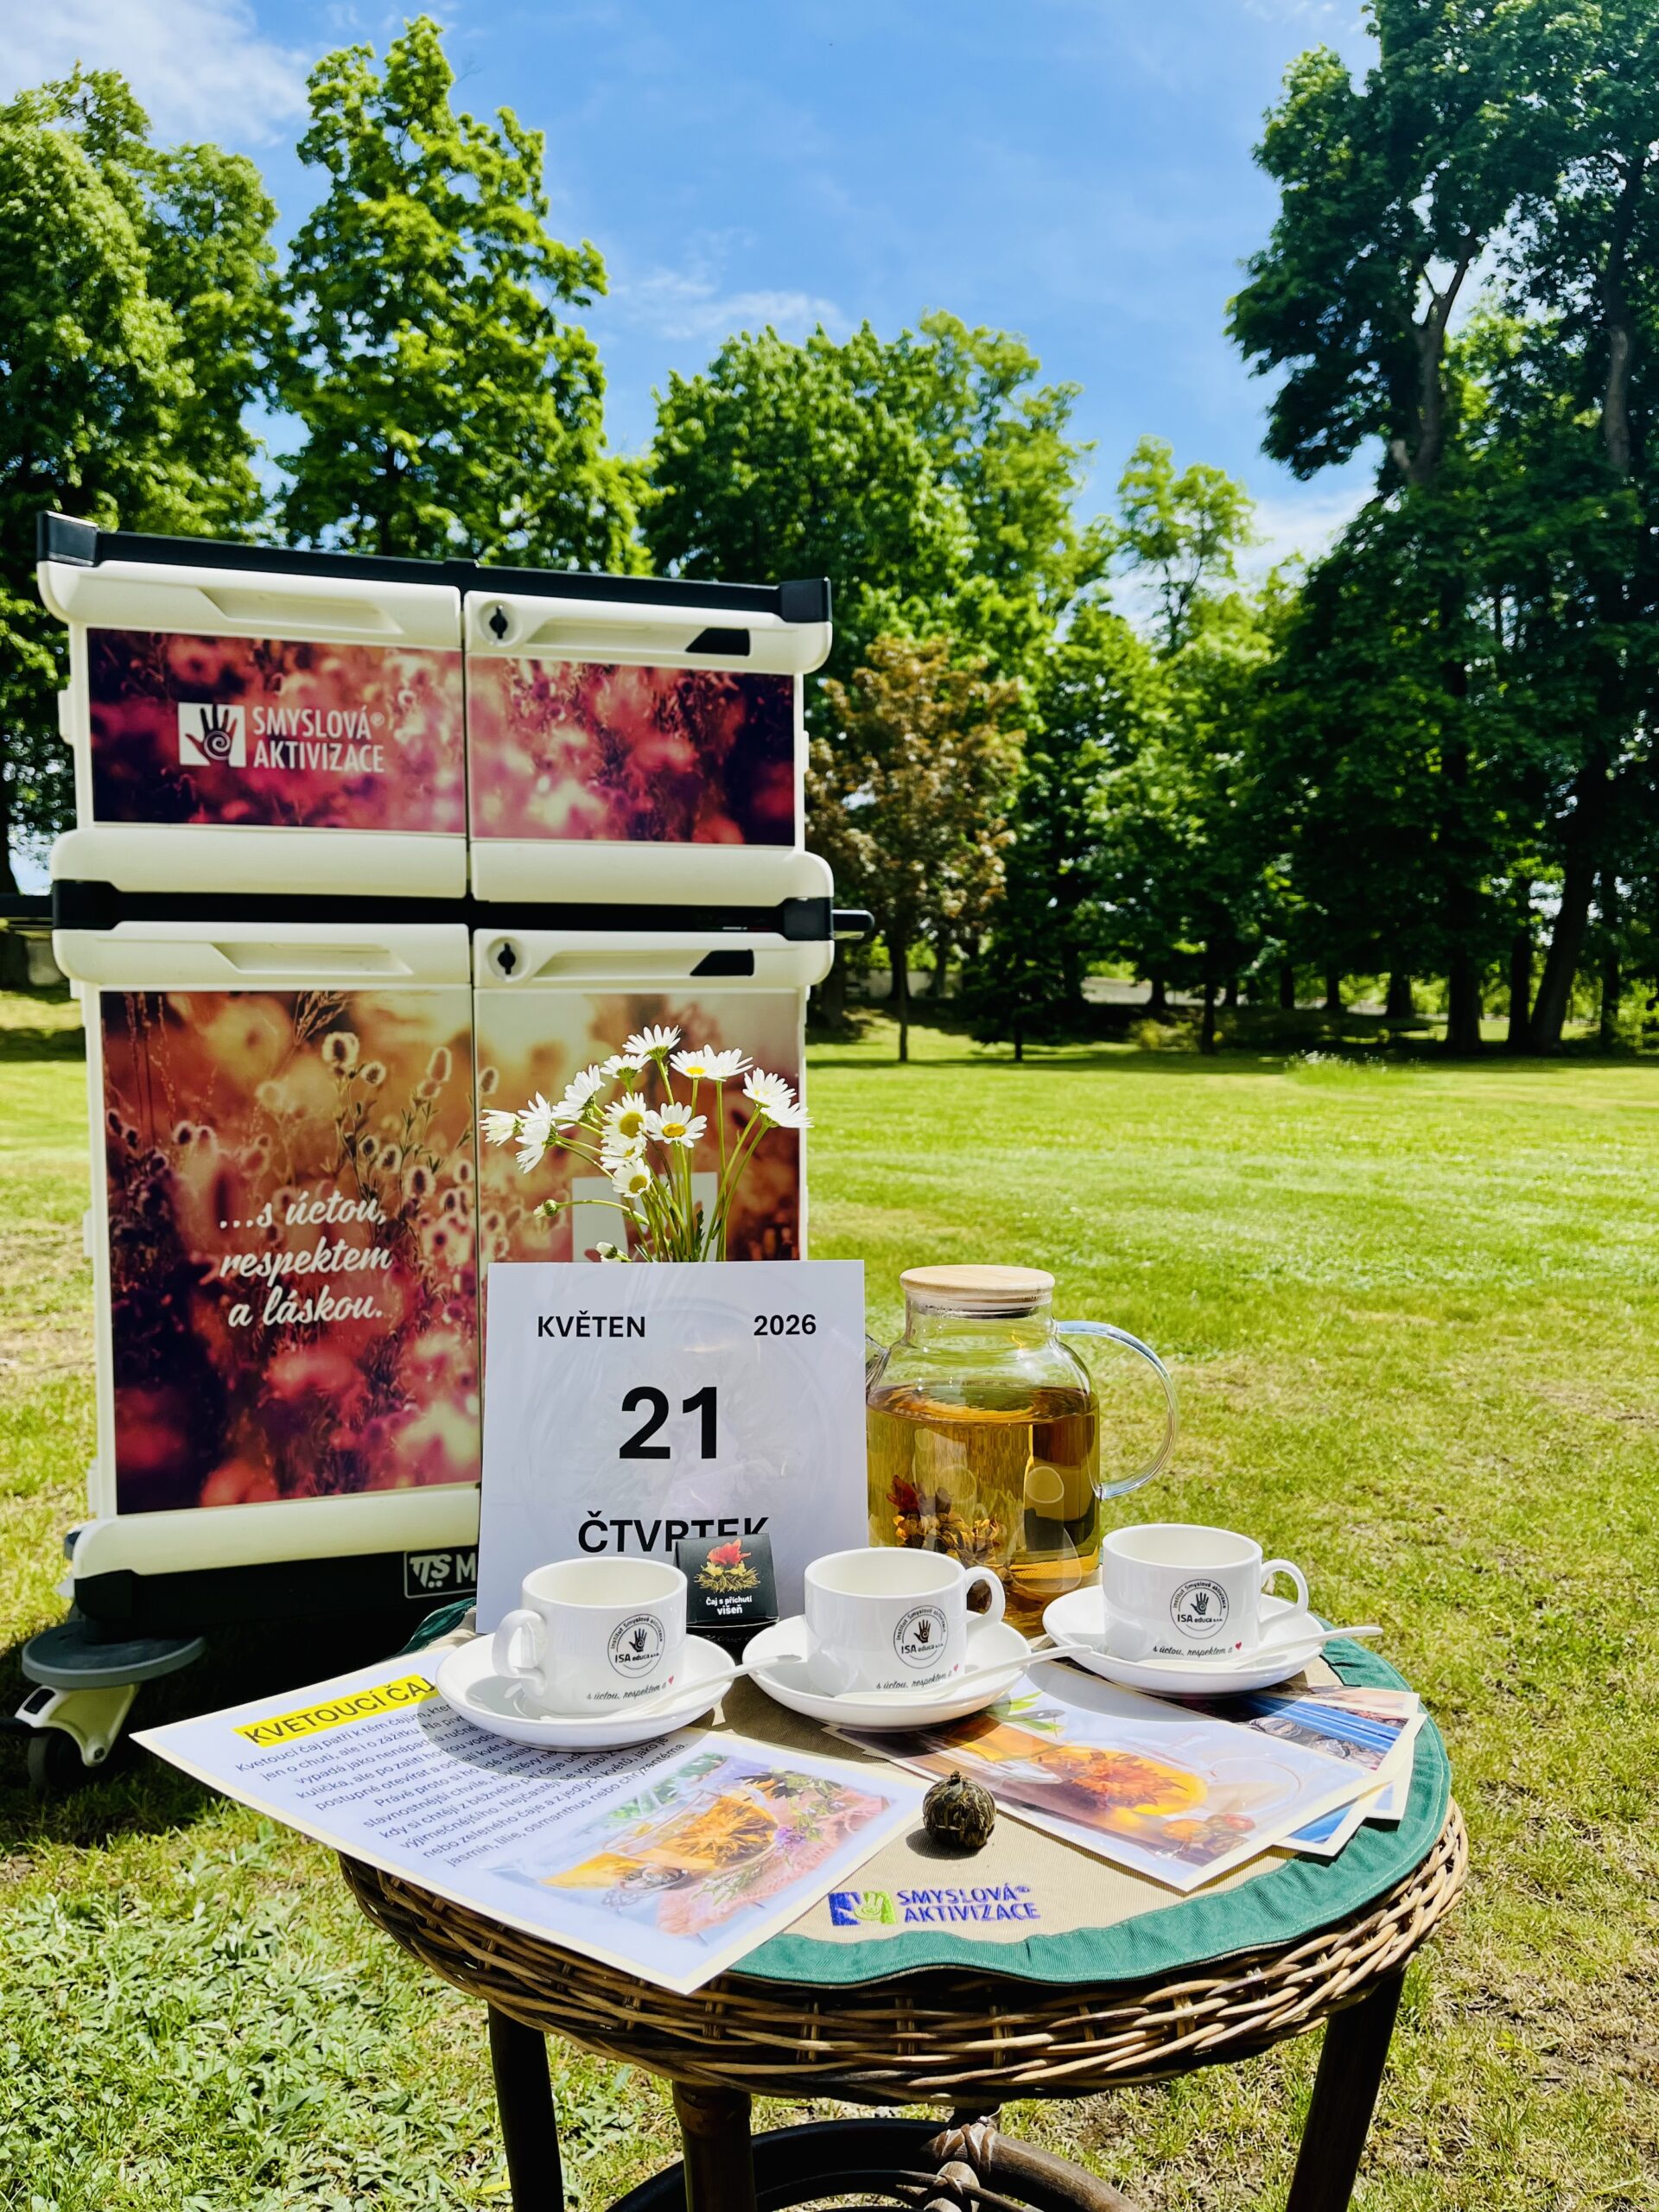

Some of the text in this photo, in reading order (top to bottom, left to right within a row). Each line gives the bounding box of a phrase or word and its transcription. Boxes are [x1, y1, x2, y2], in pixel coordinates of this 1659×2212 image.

[252, 704, 372, 740] SMYSLOVÁ
[253, 741, 385, 772] AKTIVIZACE
[285, 1190, 387, 1225] úctou,
[219, 1236, 392, 1287] respektem
[228, 1285, 383, 1327] a láskou.
[537, 1310, 817, 1338] KVĚTEN 2026
[619, 1386, 717, 1459] 21
[706, 1597, 718, 1606] Čaj
[717, 1605, 743, 1615] višeň
[1178, 1614, 1193, 1623] ISA
[615, 1654, 631, 1663] ISA
[632, 1653, 650, 1662] educa
[901, 1645, 917, 1654] ISA
[1187, 1645, 1225, 1657] respektem
[623, 1685, 660, 1699] respektem
[912, 1673, 946, 1688] respektem
[244, 1677, 435, 1743] KVETOUCÍ ČAJ
[236, 1748, 299, 1771] Kvetoucí
[299, 1741, 323, 1753] čaj
[322, 1731, 352, 1748] patří
[428, 1704, 453, 1715] kter
[260, 1769, 286, 1782] jen
[298, 1753, 340, 1769] chuti,
[339, 1745, 360, 1757] ale
[422, 1722, 442, 1731] Na
[295, 1764, 346, 1784] vypadá
[346, 1756, 376, 1770] jako
[376, 1734, 444, 1760] nenápadná
[296, 1780, 353, 1799] kulička,
[353, 1772, 375, 1782] ale
[375, 1765, 394, 1777] po
[423, 1743, 467, 1759] horkou
[315, 1784, 381, 1811] postupně
[381, 1768, 430, 1789] otevírat
[441, 1752, 479, 1770] odhalí
[476, 1745, 504, 1756] květ
[363, 1792, 450, 1827] slavnostnější
[491, 1757, 542, 1780] návštěvy
[374, 1789, 415, 1807] Právě
[415, 1778, 449, 1795] proto
[449, 1772, 463, 1781] si
[462, 1767, 480, 1777] ho
[477, 1758, 502, 1770] lidé
[560, 1773, 575, 1782] se
[378, 1825, 408, 1838] kdy
[408, 1819, 422, 1829] si
[467, 1782, 521, 1805] běžného
[540, 1762, 565, 1775] čaje
[423, 1840, 459, 1858] nebo
[459, 1815, 519, 1844] zeleného
[518, 1803, 546, 1817] čaje
[562, 1774, 604, 1799] jedlých
[637, 1744, 658, 1758] jako
[656, 1737, 669, 1746] je
[524, 1799, 592, 1832] osmanthus
[589, 1783, 620, 1801] nebo
[897, 1883, 1017, 1906] SMYSLOVÁ
[905, 1903, 1041, 1923] AKTIVIZACE
